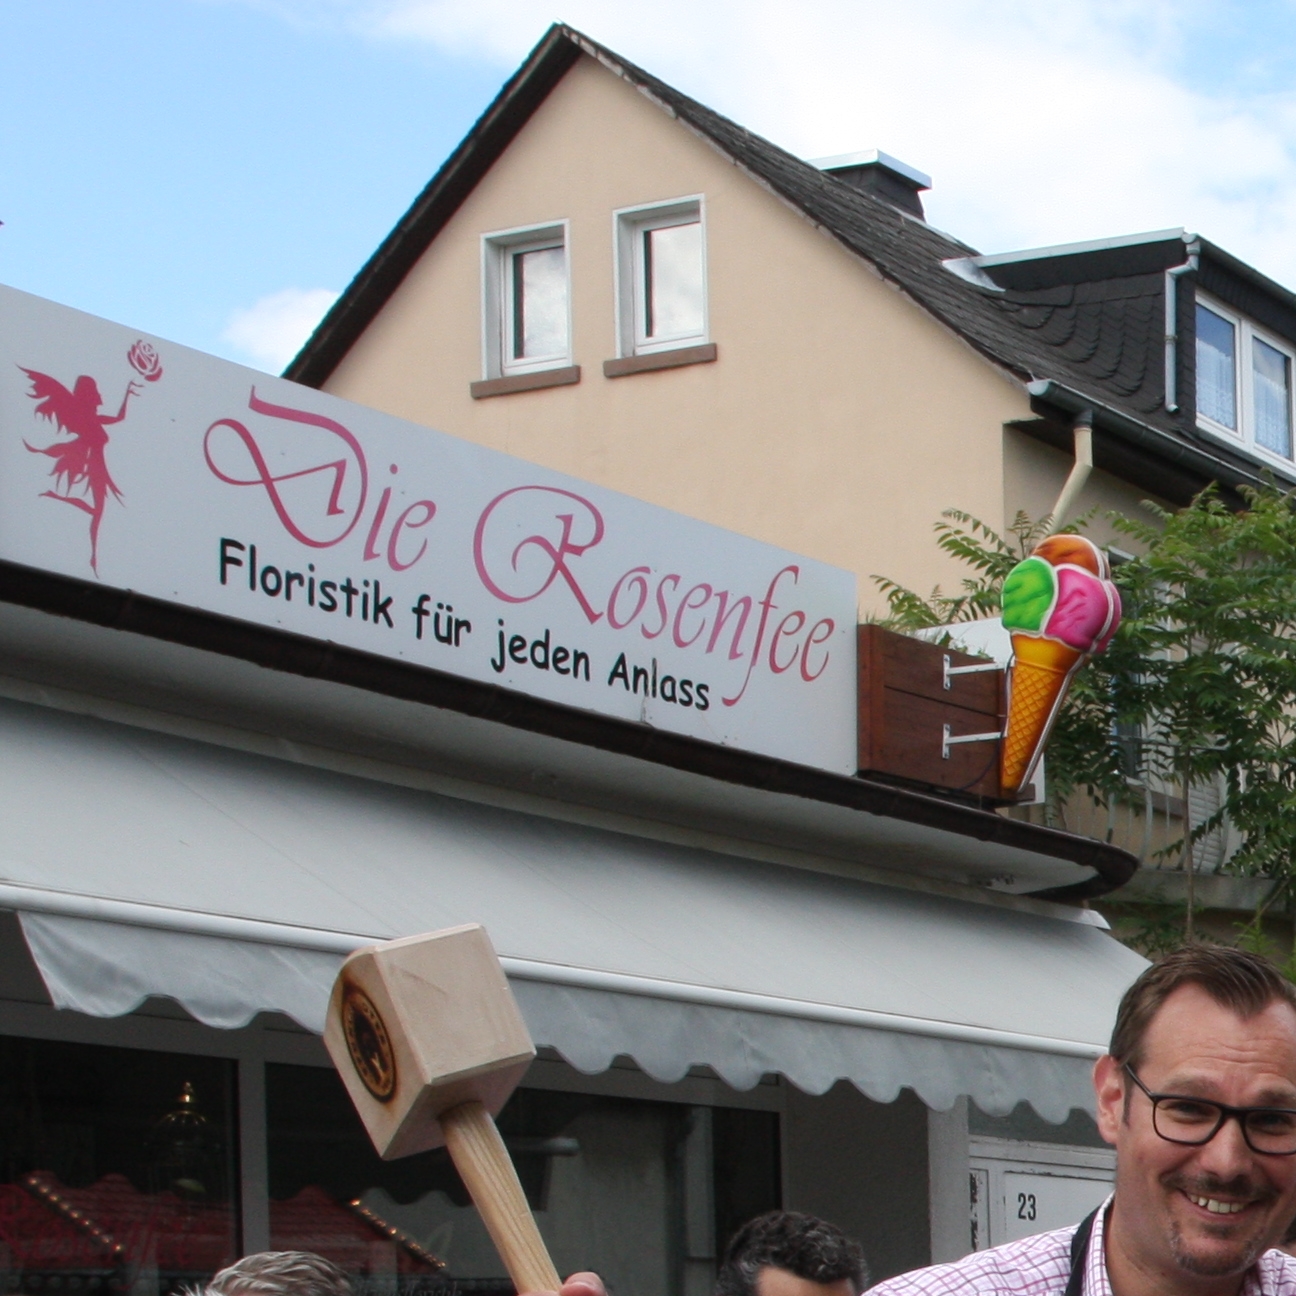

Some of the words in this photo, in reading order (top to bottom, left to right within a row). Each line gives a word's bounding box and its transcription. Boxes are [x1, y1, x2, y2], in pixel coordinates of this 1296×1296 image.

[203, 384, 437, 572] Die
[473, 485, 835, 707] Rosenfee
[219, 537, 394, 628] Floristik
[411, 594, 472, 647] für
[490, 619, 591, 681] jeden
[607, 652, 710, 711] Anlass
[1017, 1192, 1037, 1221] 23
